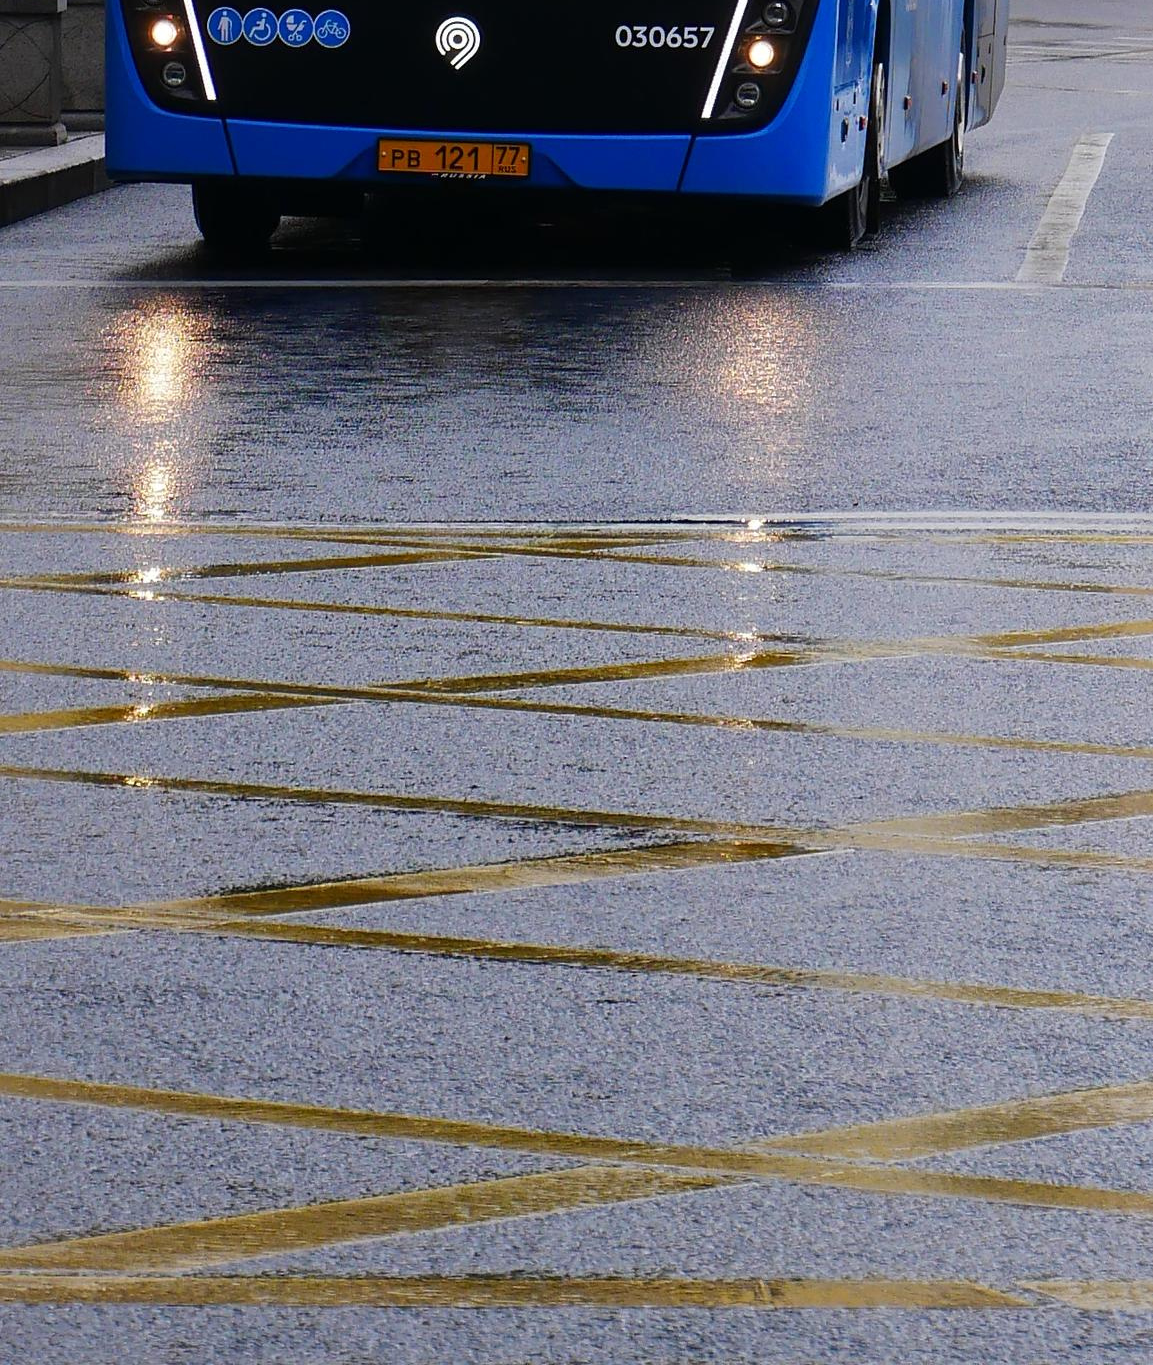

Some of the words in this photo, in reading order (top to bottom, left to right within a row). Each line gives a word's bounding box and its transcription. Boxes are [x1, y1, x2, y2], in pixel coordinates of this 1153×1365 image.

[615, 25, 715, 48] 030657
[434, 145, 480, 171] 121
[495, 146, 521, 166] 77
[498, 165, 517, 174] RUS
